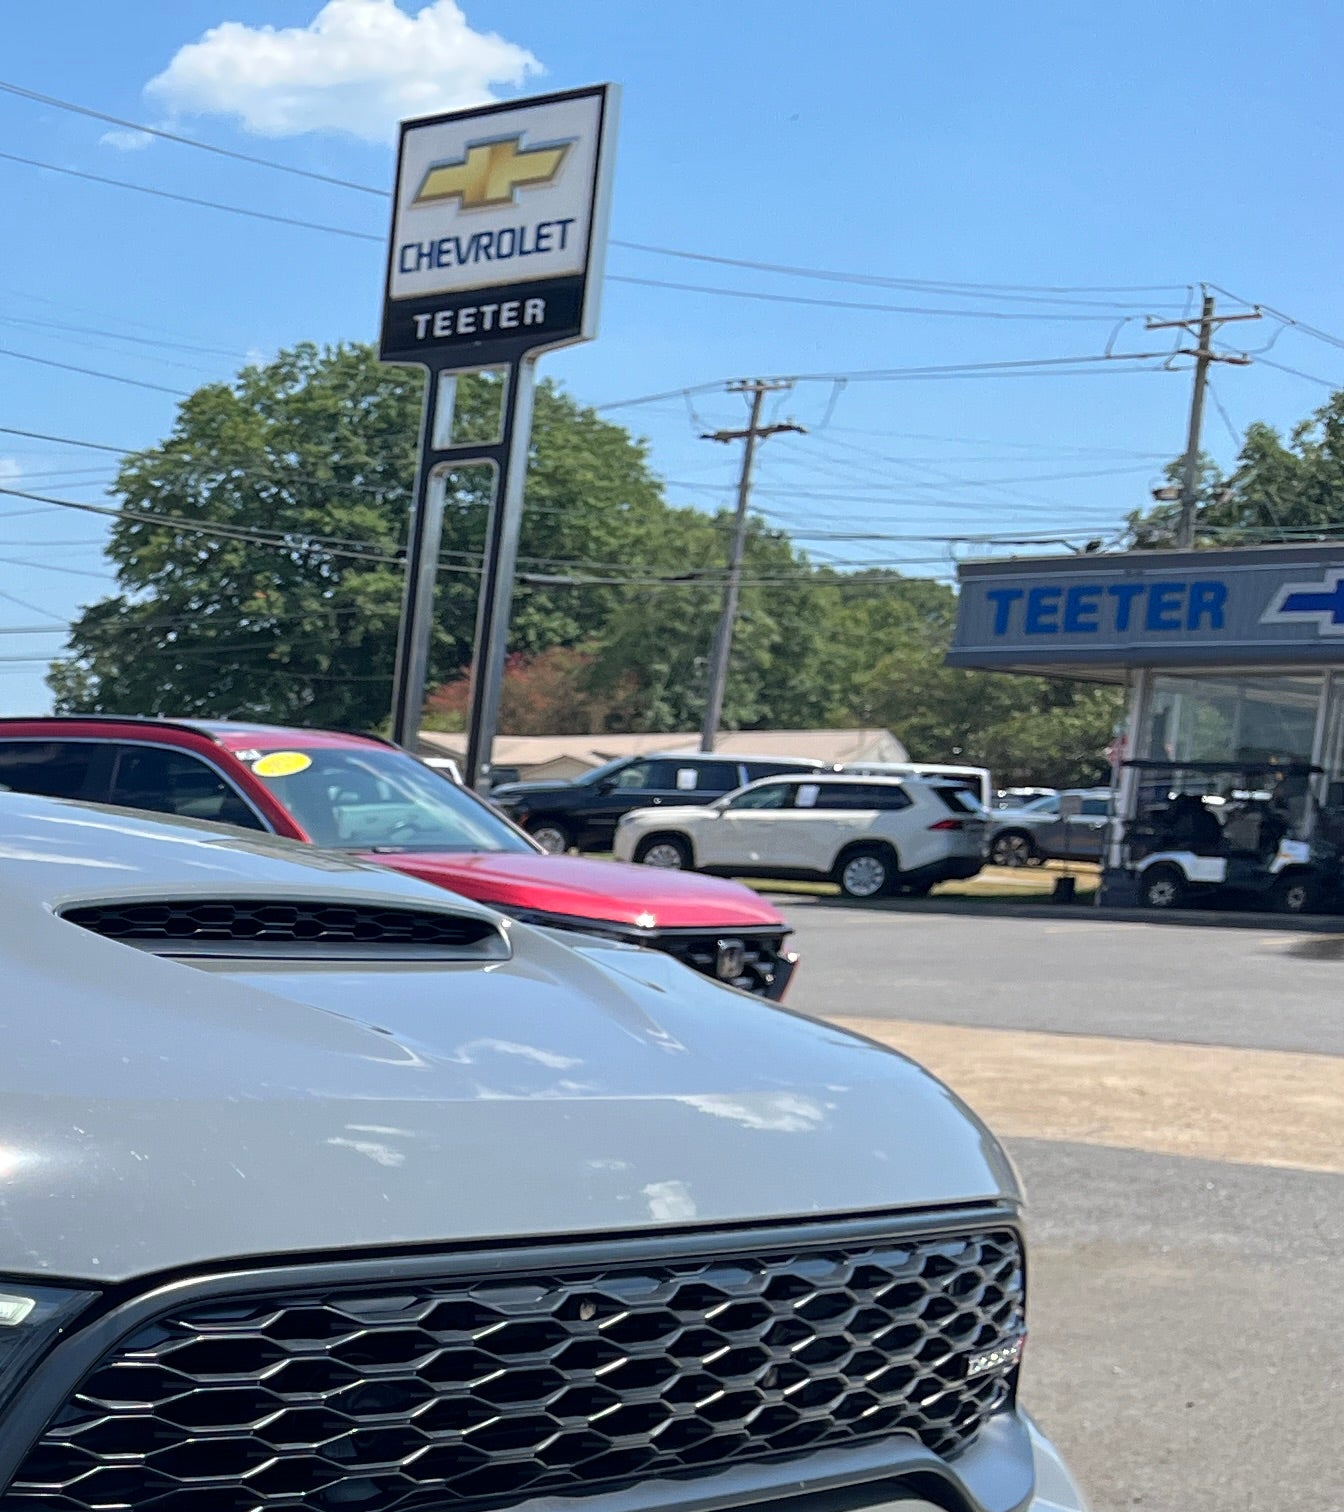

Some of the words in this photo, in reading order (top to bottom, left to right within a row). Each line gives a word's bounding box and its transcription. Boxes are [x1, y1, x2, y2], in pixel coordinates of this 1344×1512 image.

[399, 218, 575, 274] CHEVROLET
[413, 298, 547, 340] TEETER
[986, 580, 1229, 636] TEETER
